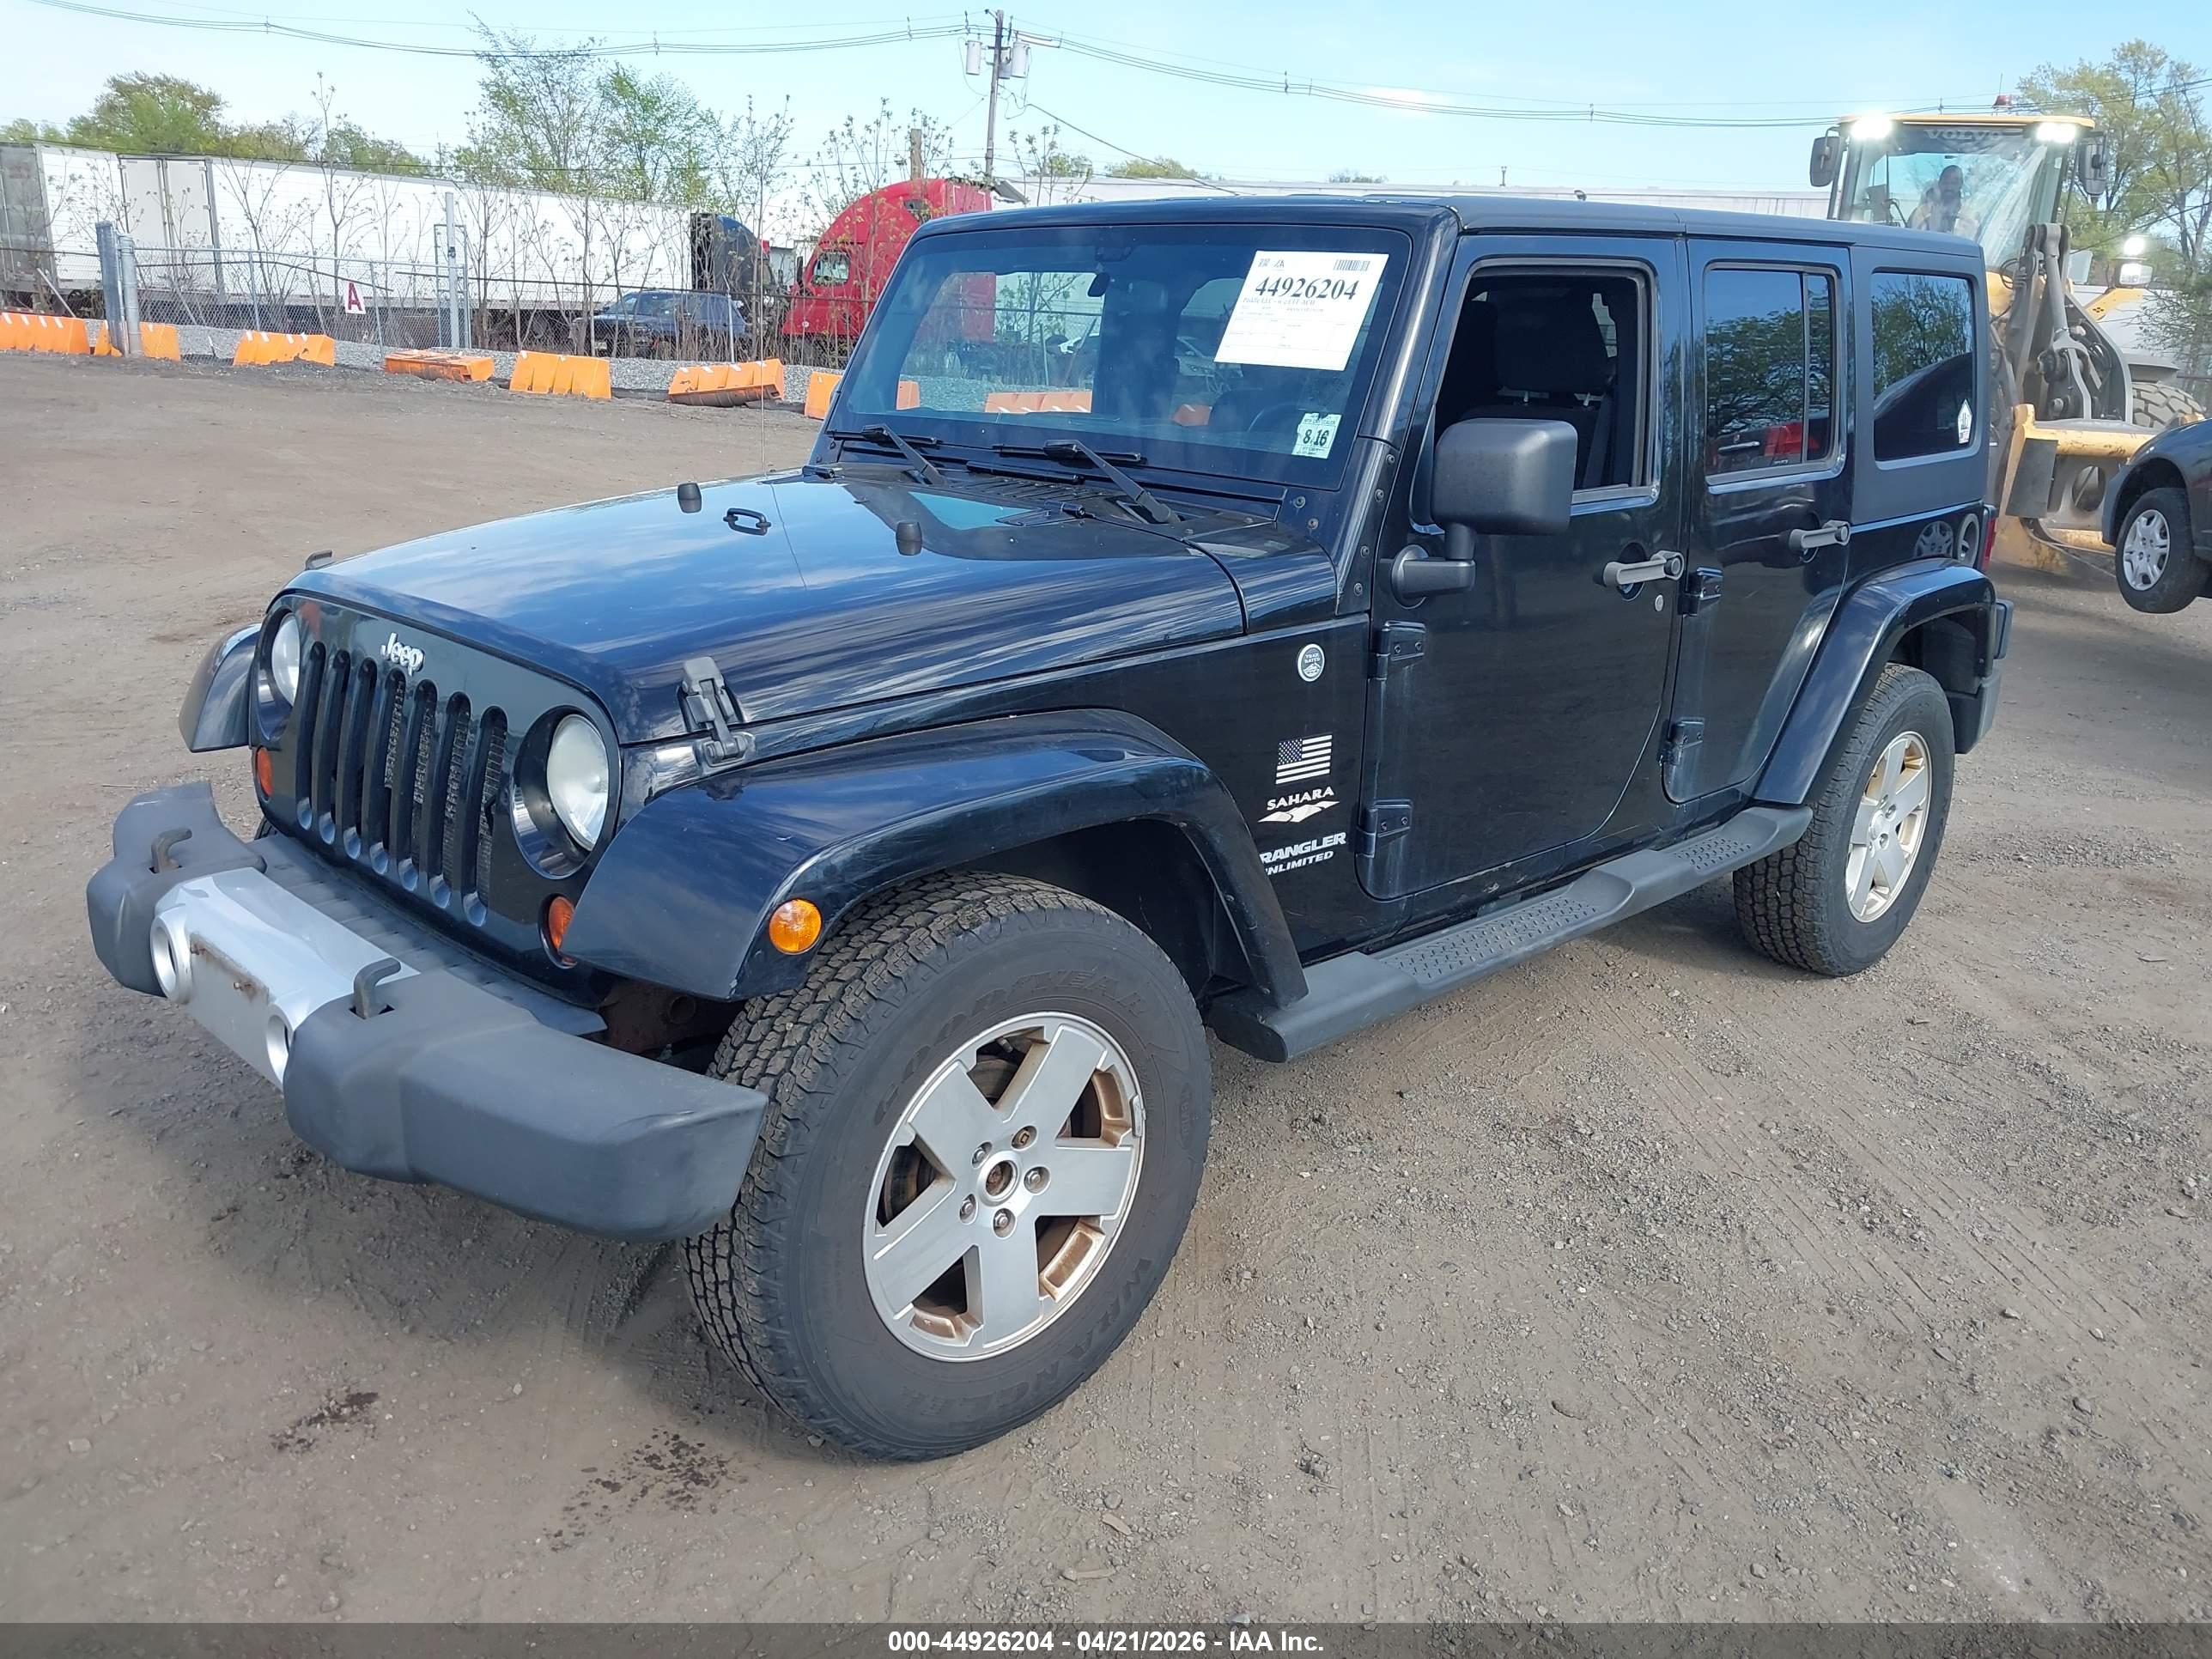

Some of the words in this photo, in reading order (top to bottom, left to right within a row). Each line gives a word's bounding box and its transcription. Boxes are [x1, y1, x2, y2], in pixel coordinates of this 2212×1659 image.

[1923, 129, 2004, 141] VOLVO
[348, 282, 363, 311] A
[1255, 276, 1360, 301] 44926204
[380, 632, 425, 677] Jeep
[1267, 787, 1334, 811] SAHARA
[1259, 832, 1346, 864] RANGLER
[1265, 851, 1334, 876] NLIMITED
